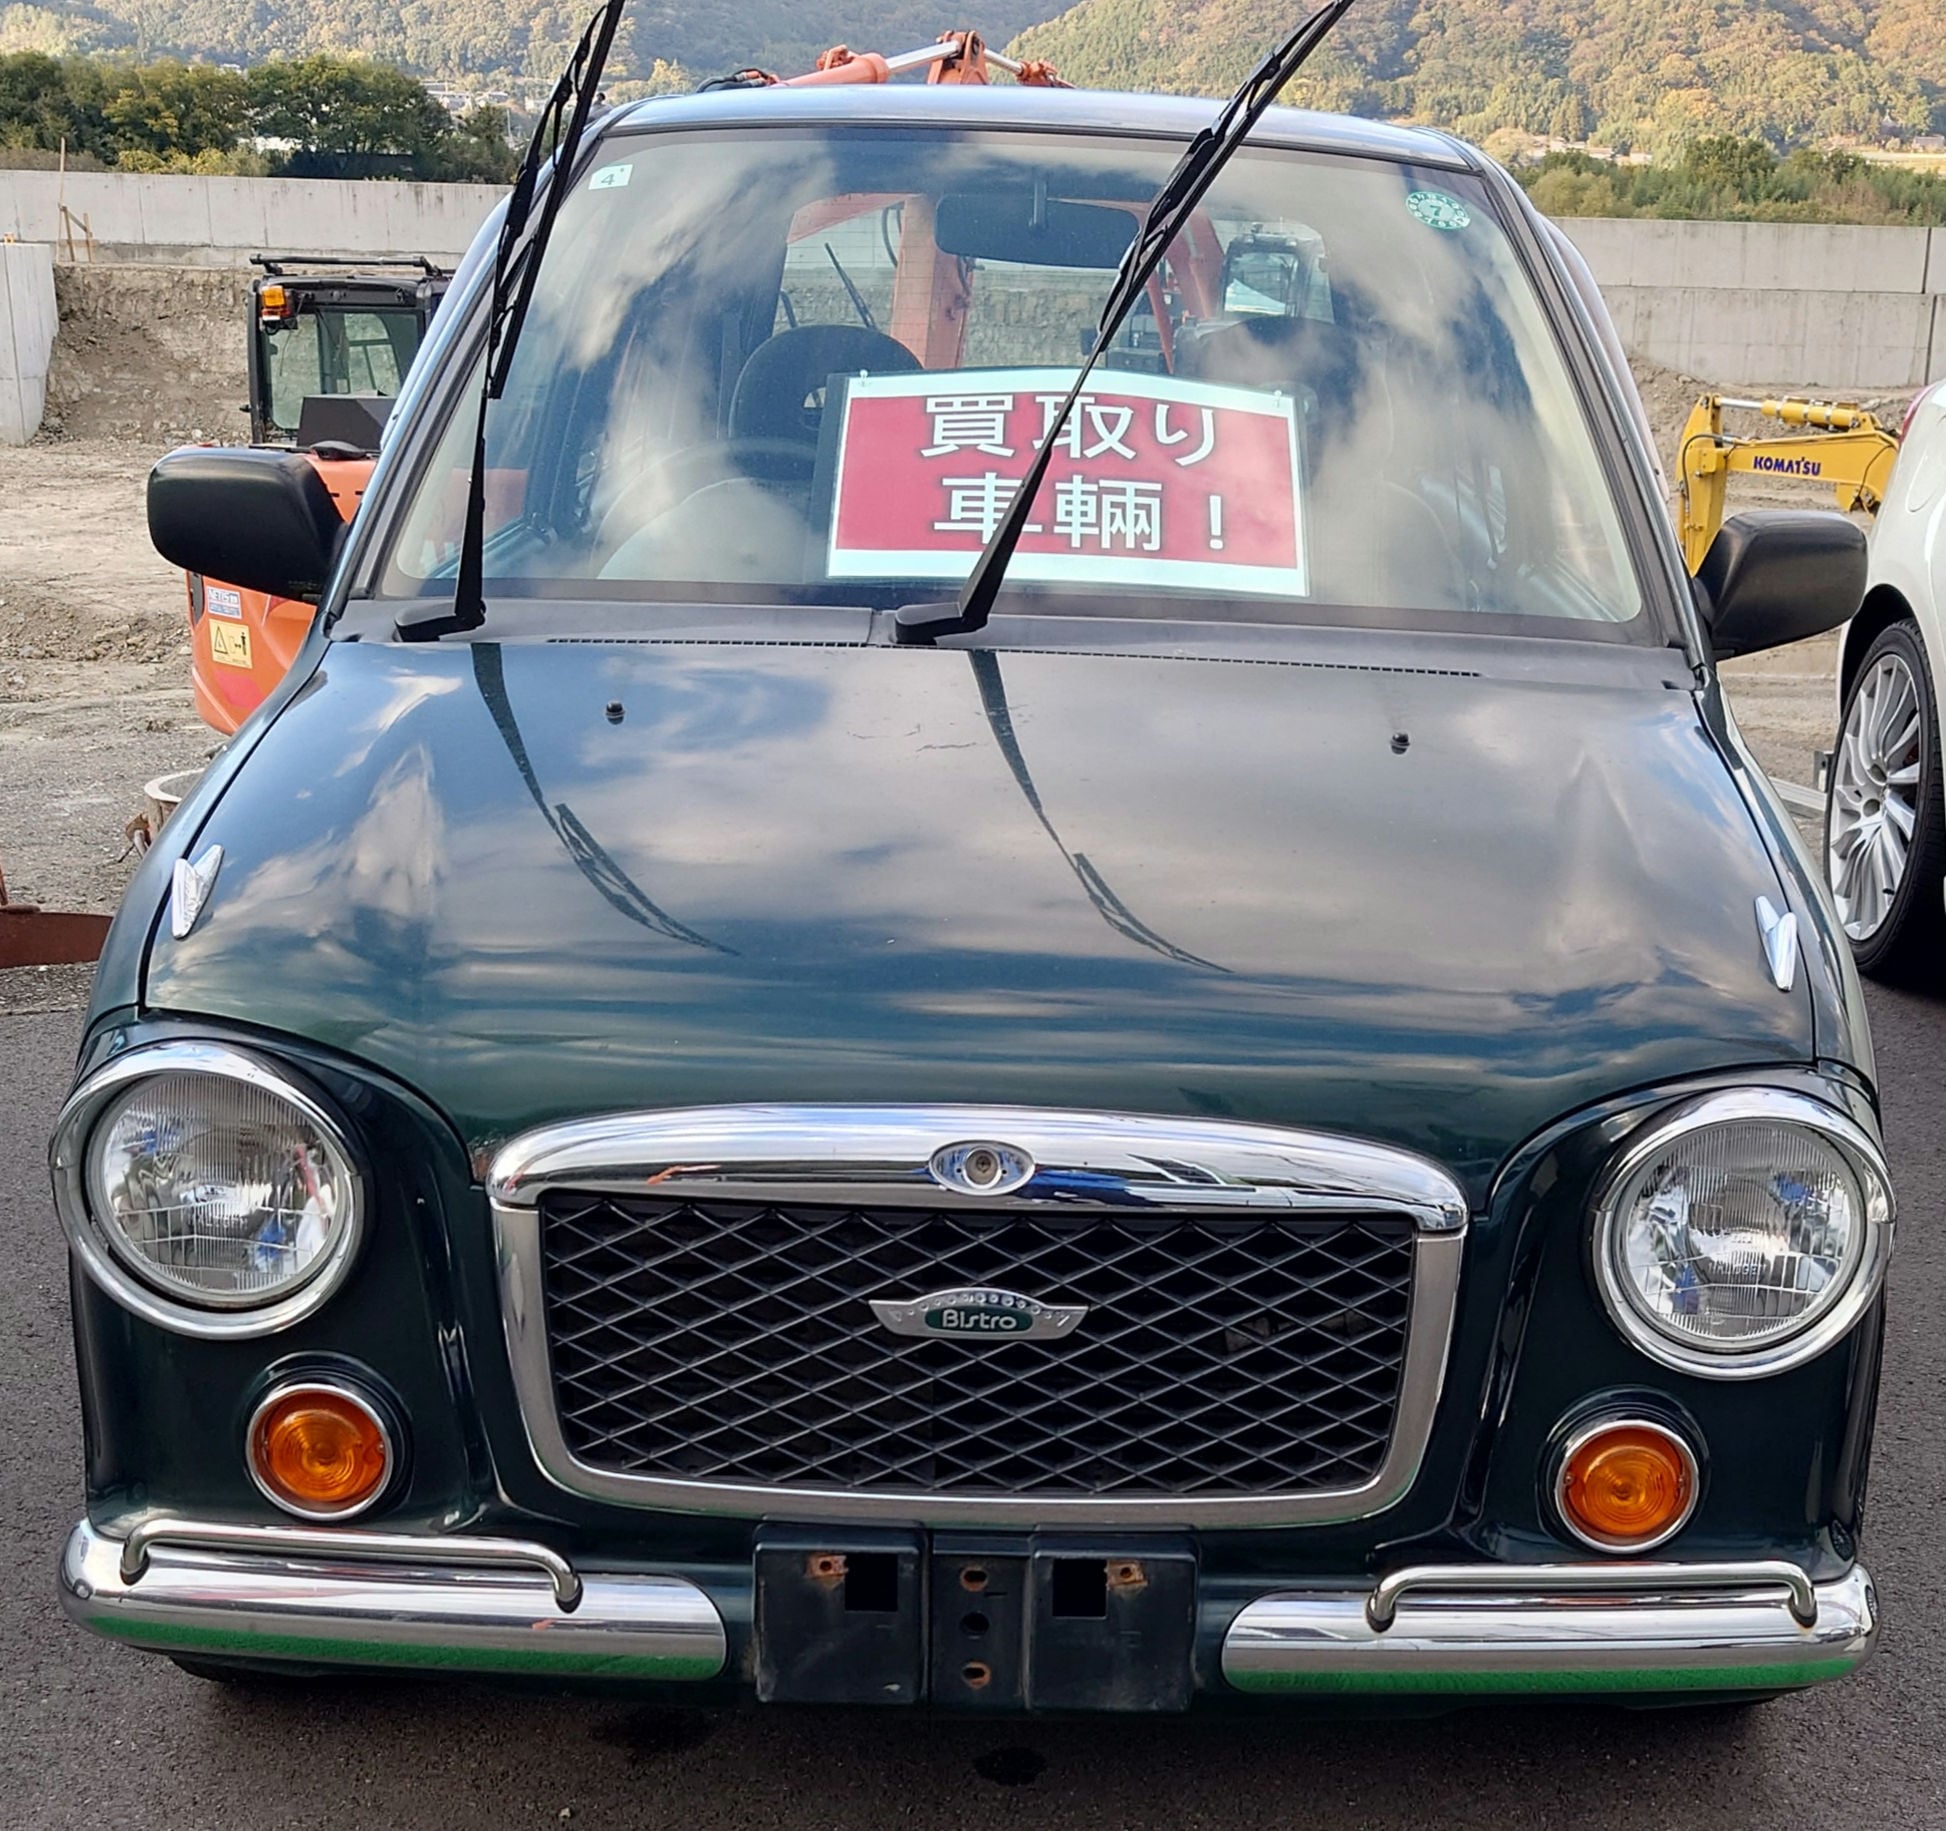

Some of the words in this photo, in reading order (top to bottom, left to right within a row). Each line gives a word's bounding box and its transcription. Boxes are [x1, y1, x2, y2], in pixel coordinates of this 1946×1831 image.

[601, 174, 615, 185] 4
[1430, 205, 1442, 217] 7
[921, 394, 1215, 467] 買取り
[1753, 456, 1821, 475] KOMATSU
[942, 1308, 1017, 1330] Bistro
